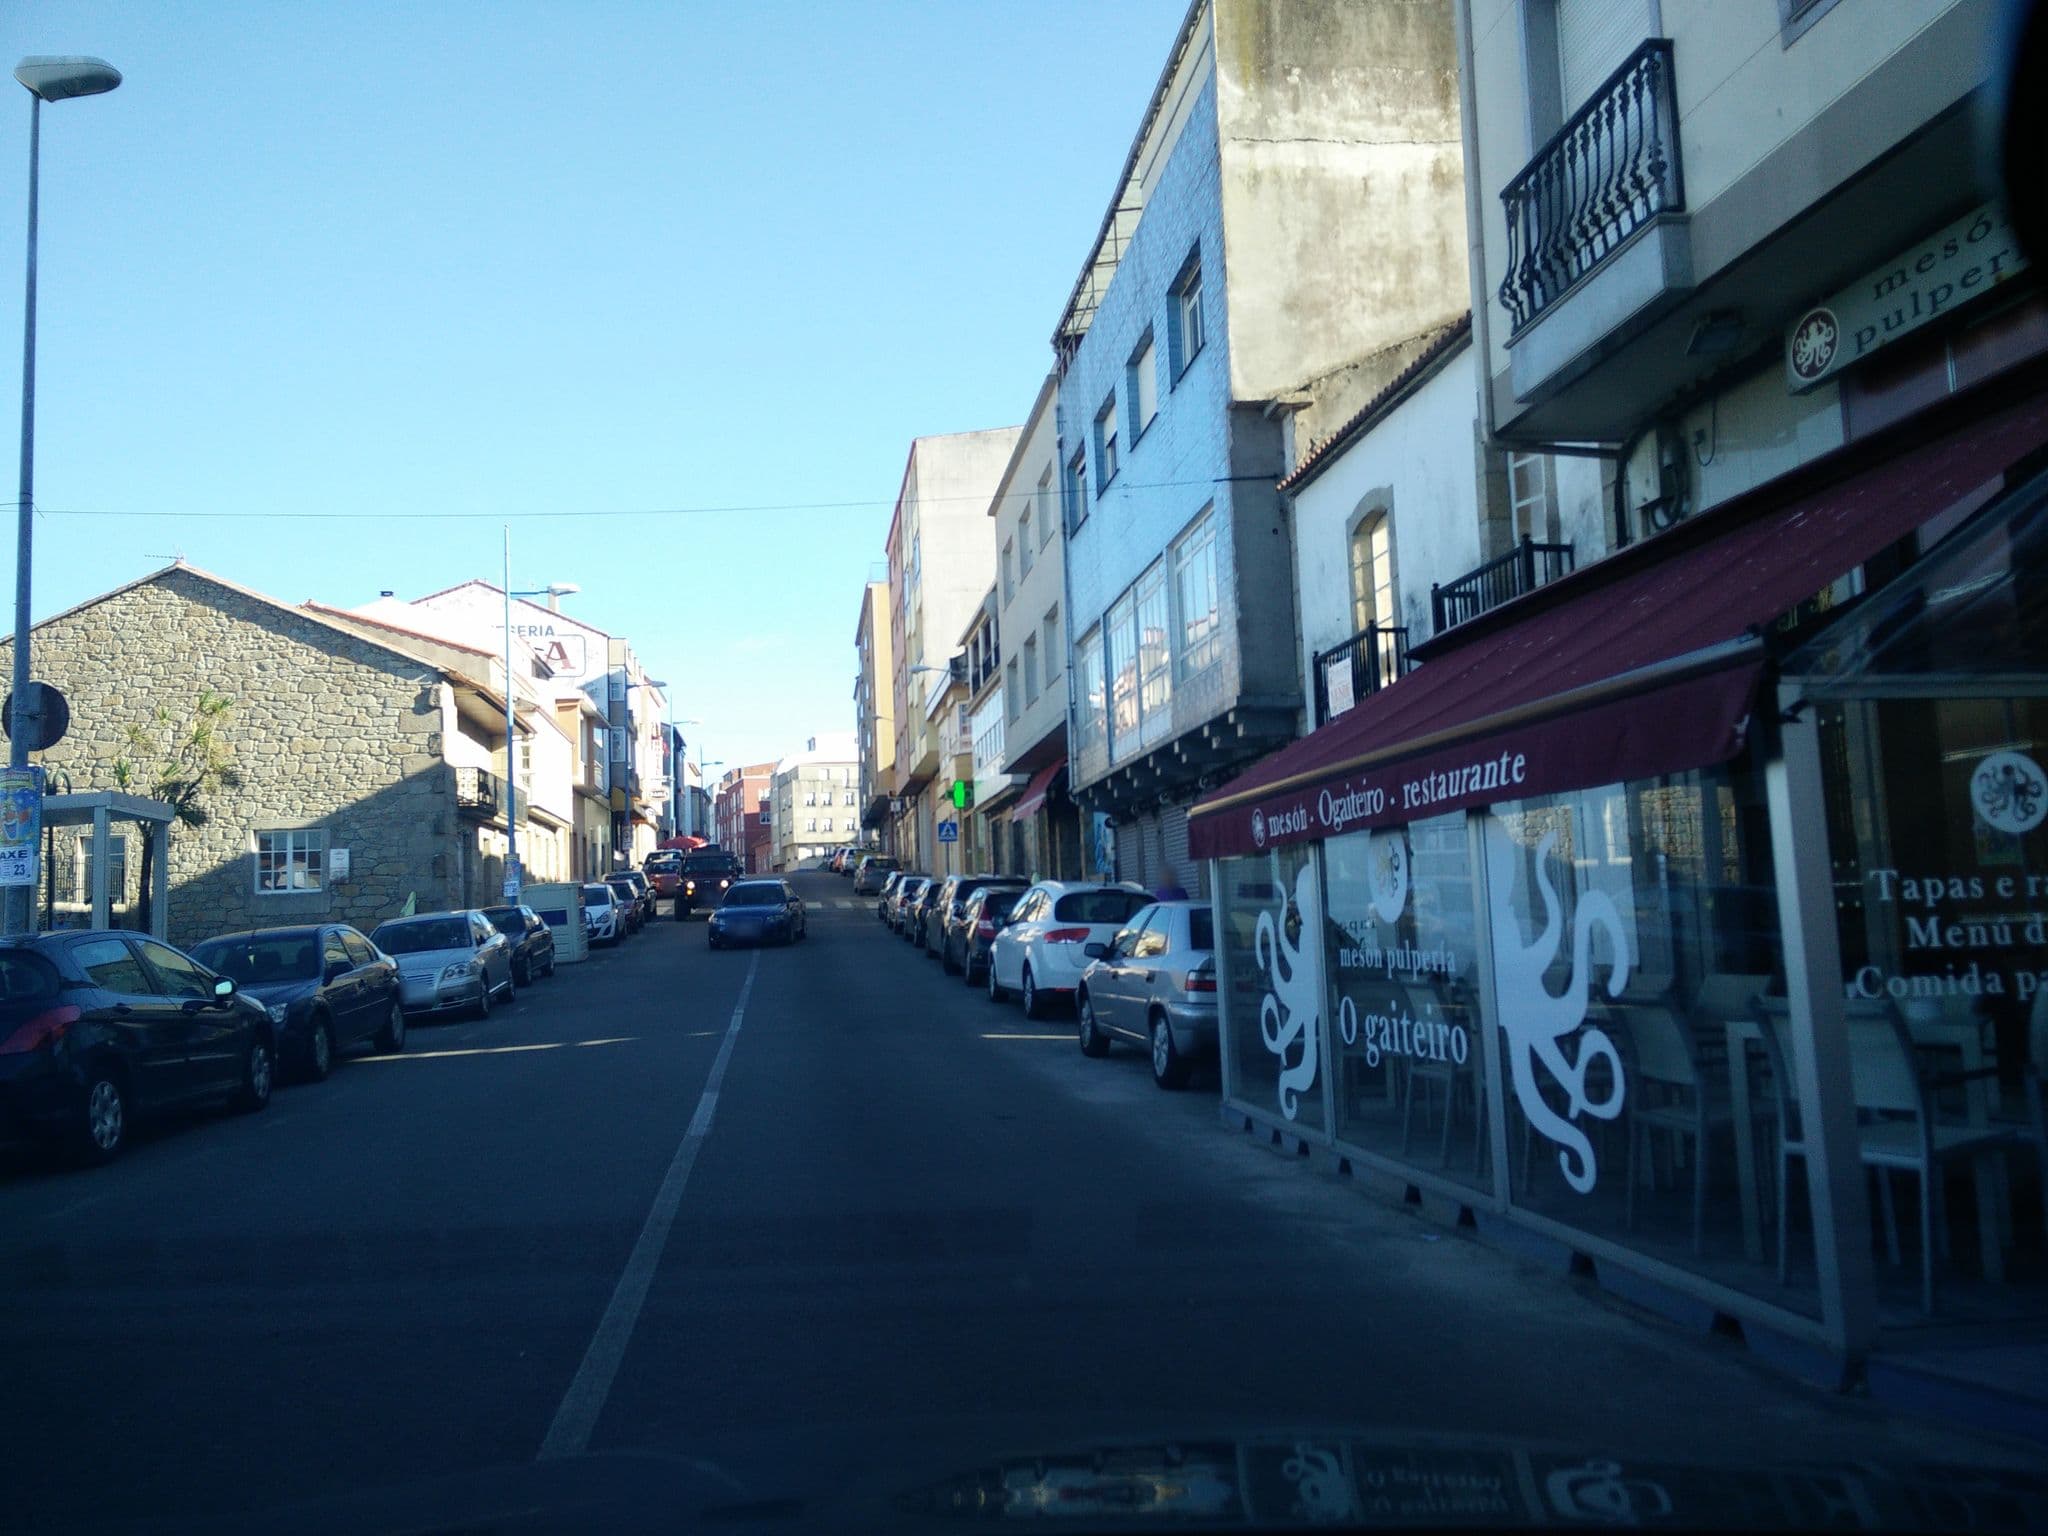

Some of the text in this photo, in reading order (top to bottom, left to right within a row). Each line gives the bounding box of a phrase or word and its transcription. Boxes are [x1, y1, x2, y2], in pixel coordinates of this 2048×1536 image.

[1873, 213, 2008, 300] mesó
[1854, 250, 2026, 354] pulper
[1268, 803, 1308, 837] mesón
[1403, 751, 1526, 809] restaurante
[13, 864, 26, 876] 23
[1869, 869, 1985, 907] Tapas
[1996, 876, 2014, 897] e
[1906, 914, 2013, 948] Menú
[1855, 961, 2005, 999] Comida
[1339, 996, 1468, 1068] O gaiteiro
